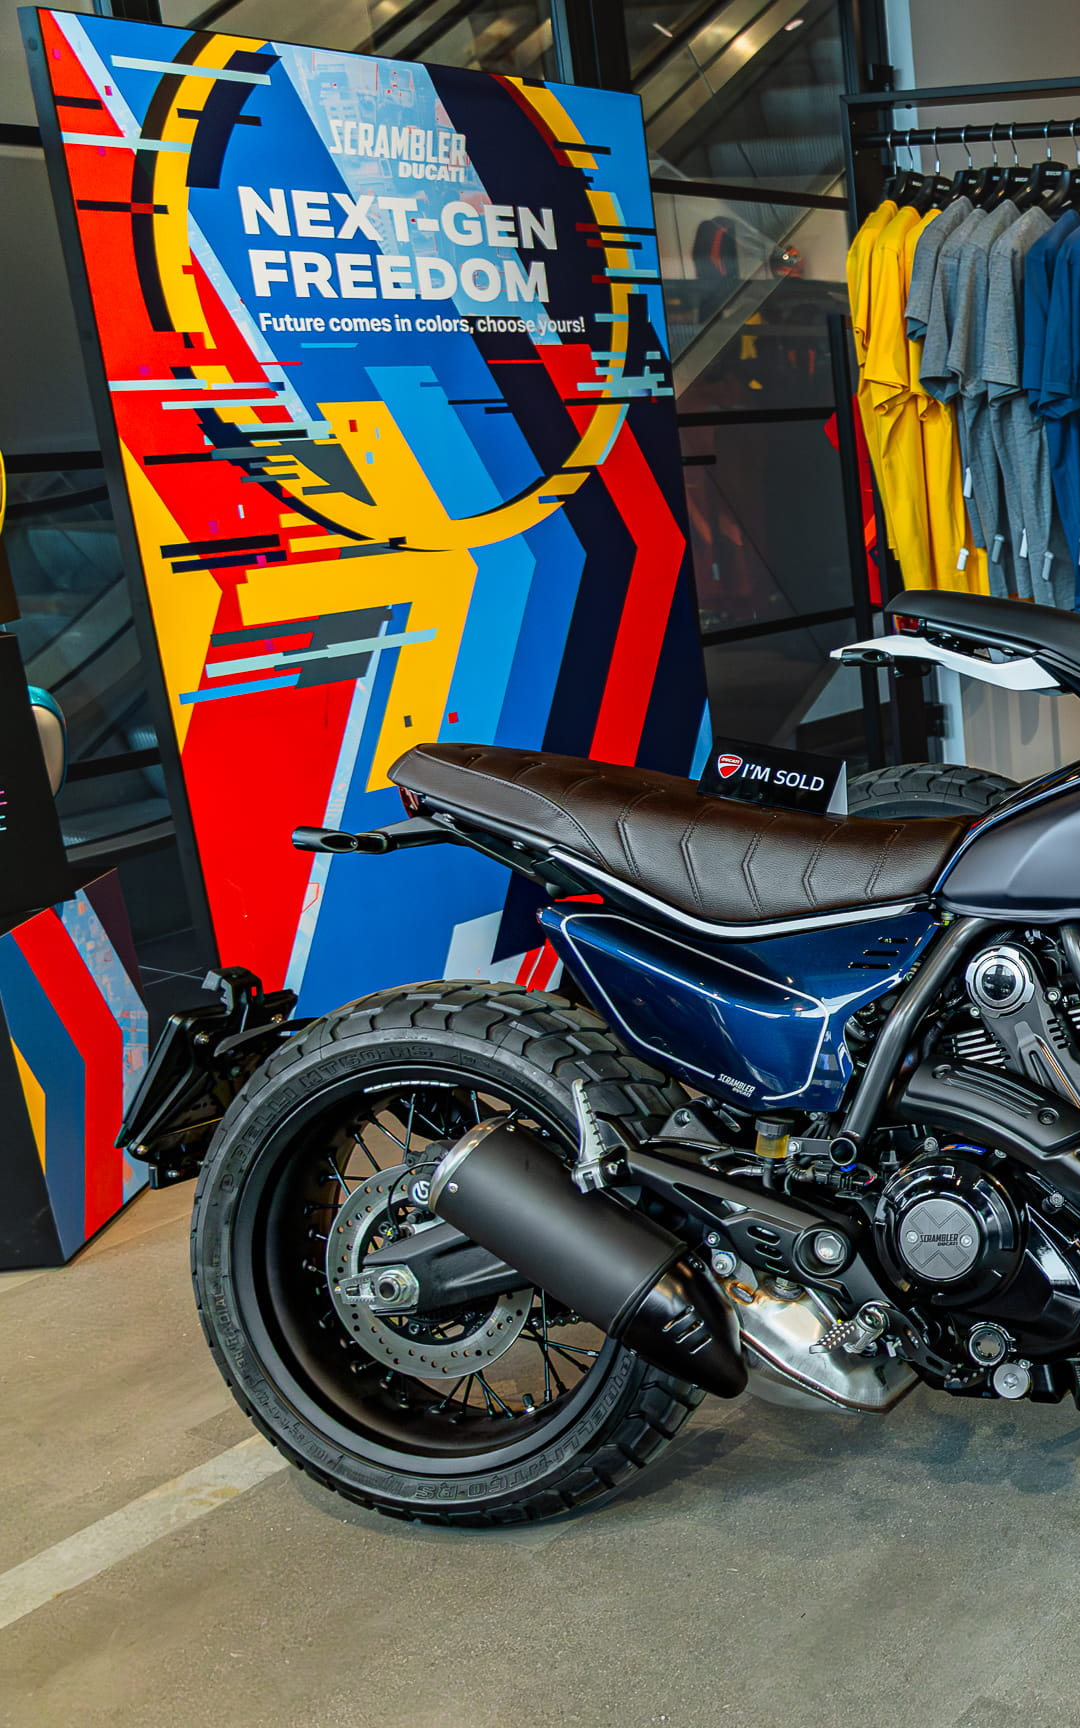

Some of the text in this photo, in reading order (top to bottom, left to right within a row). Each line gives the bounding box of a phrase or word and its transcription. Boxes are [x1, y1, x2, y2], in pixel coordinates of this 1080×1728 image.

[330, 119, 468, 167] SCRAMBLER
[399, 161, 466, 183] DUCATI
[238, 185, 558, 250] NEXT-GEN
[248, 249, 550, 303] FREEDOM
[258, 312, 586, 335] Future comes in colors, choose yours!
[741, 763, 825, 792] I'M SOLD
[718, 1073, 756, 1093] SCRAMBLER
[920, 1233, 959, 1243] SCRAMBLER
